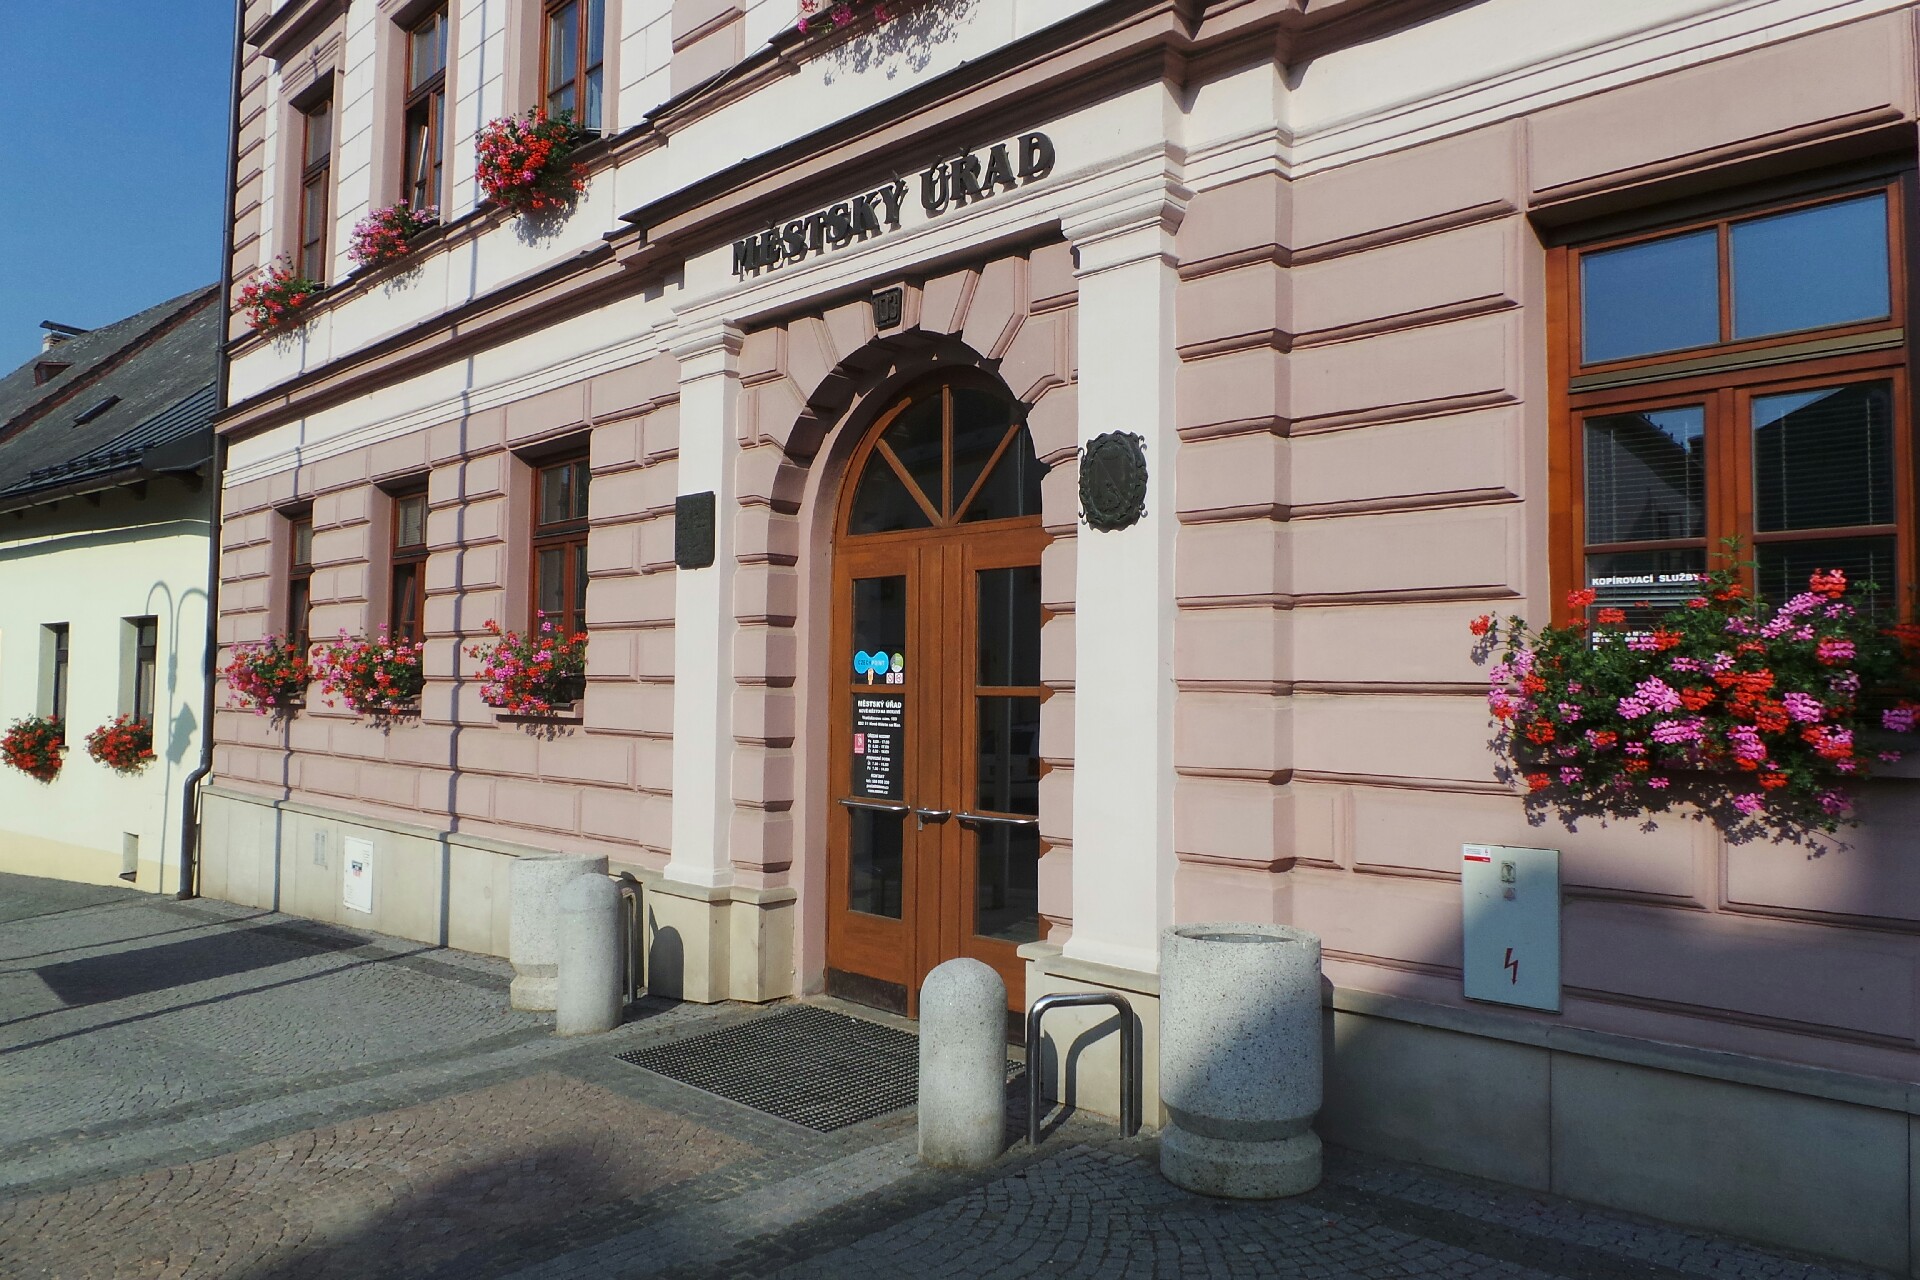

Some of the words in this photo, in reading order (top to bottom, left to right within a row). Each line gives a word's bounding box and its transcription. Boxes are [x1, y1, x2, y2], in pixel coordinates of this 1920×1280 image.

[732, 170, 909, 278] MĚSTSKÝ
[919, 131, 1056, 214] ÚŘAD
[1592, 574, 1653, 586] KOPÍROVACÍ
[858, 699, 884, 708] MĚSTSKÝ
[885, 699, 902, 708] ÚŘAD
